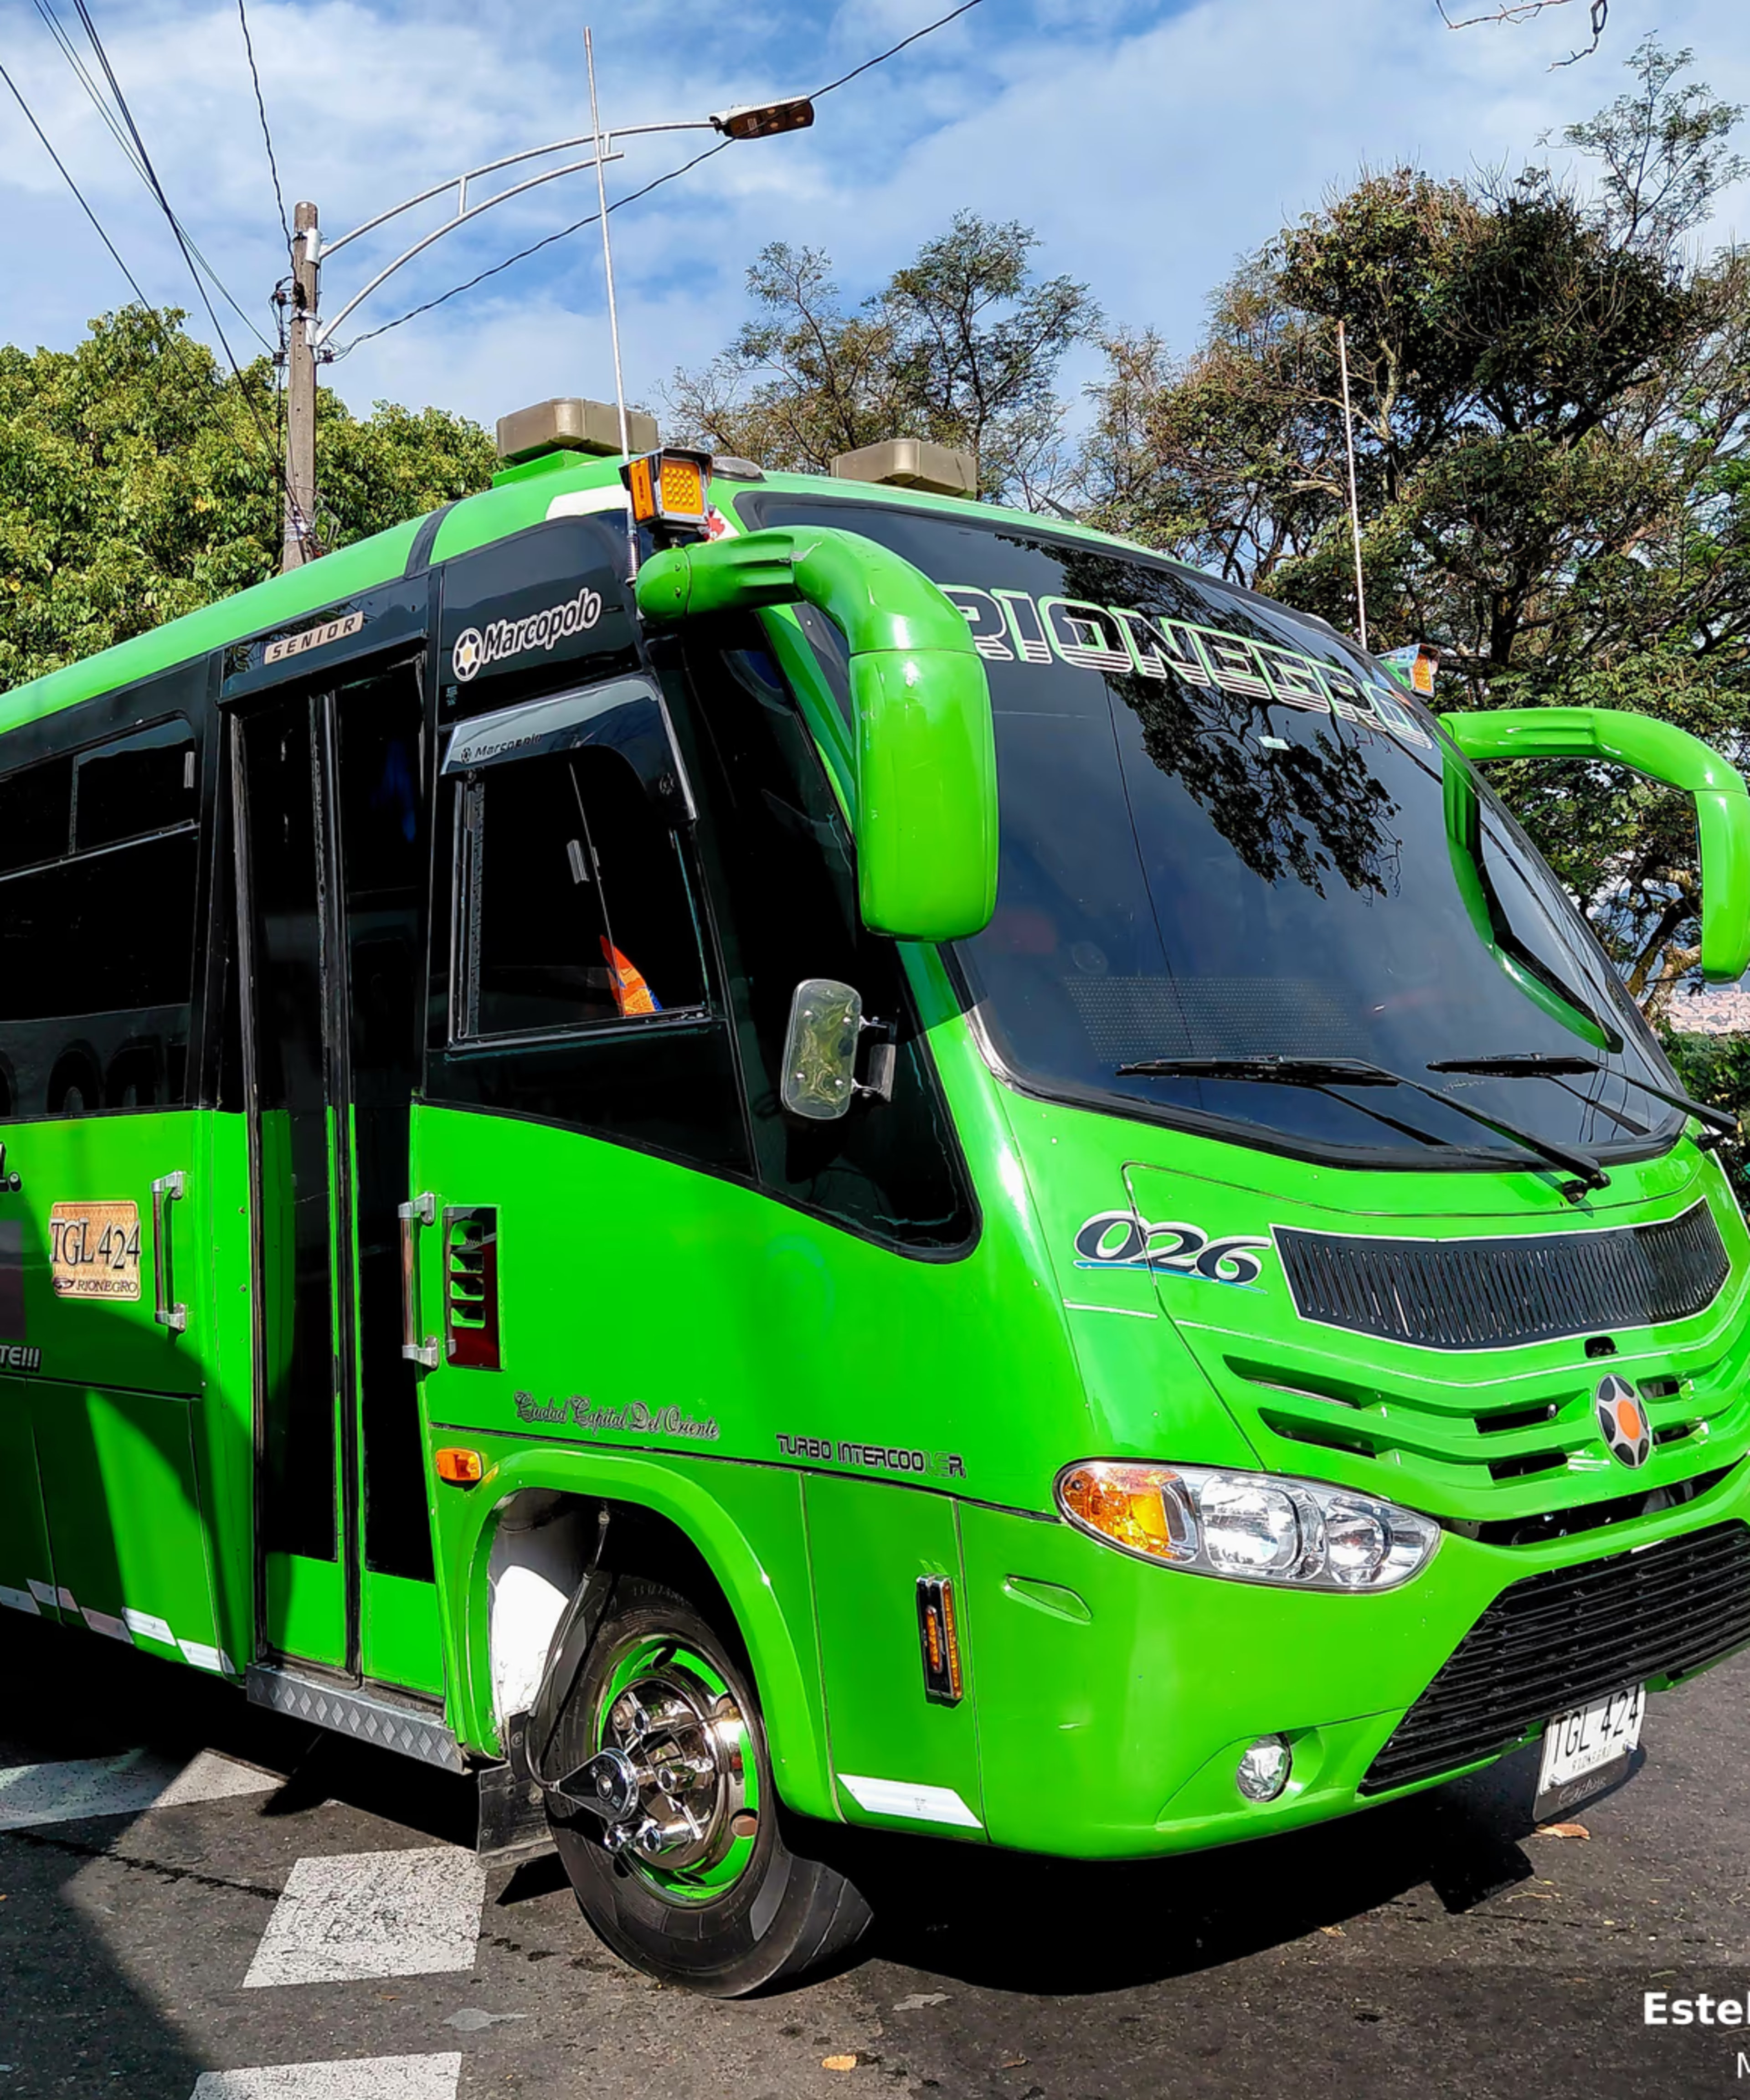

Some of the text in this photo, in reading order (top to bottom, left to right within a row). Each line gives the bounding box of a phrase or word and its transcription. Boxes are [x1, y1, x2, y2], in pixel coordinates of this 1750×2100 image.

[272, 617, 355, 659] SENIOR
[482, 587, 602, 665] Marcopolo
[474, 732, 542, 758] Marcopolo
[49, 1217, 141, 1270] TGL 424
[1074, 1210, 1272, 1284] 026
[77, 1279, 137, 1293] RIONEGRO
[514, 1390, 721, 1441] Ciudad Capital Del Oriente
[776, 1434, 833, 1461] TURBO
[1554, 1685, 1639, 1765] TGL 424
